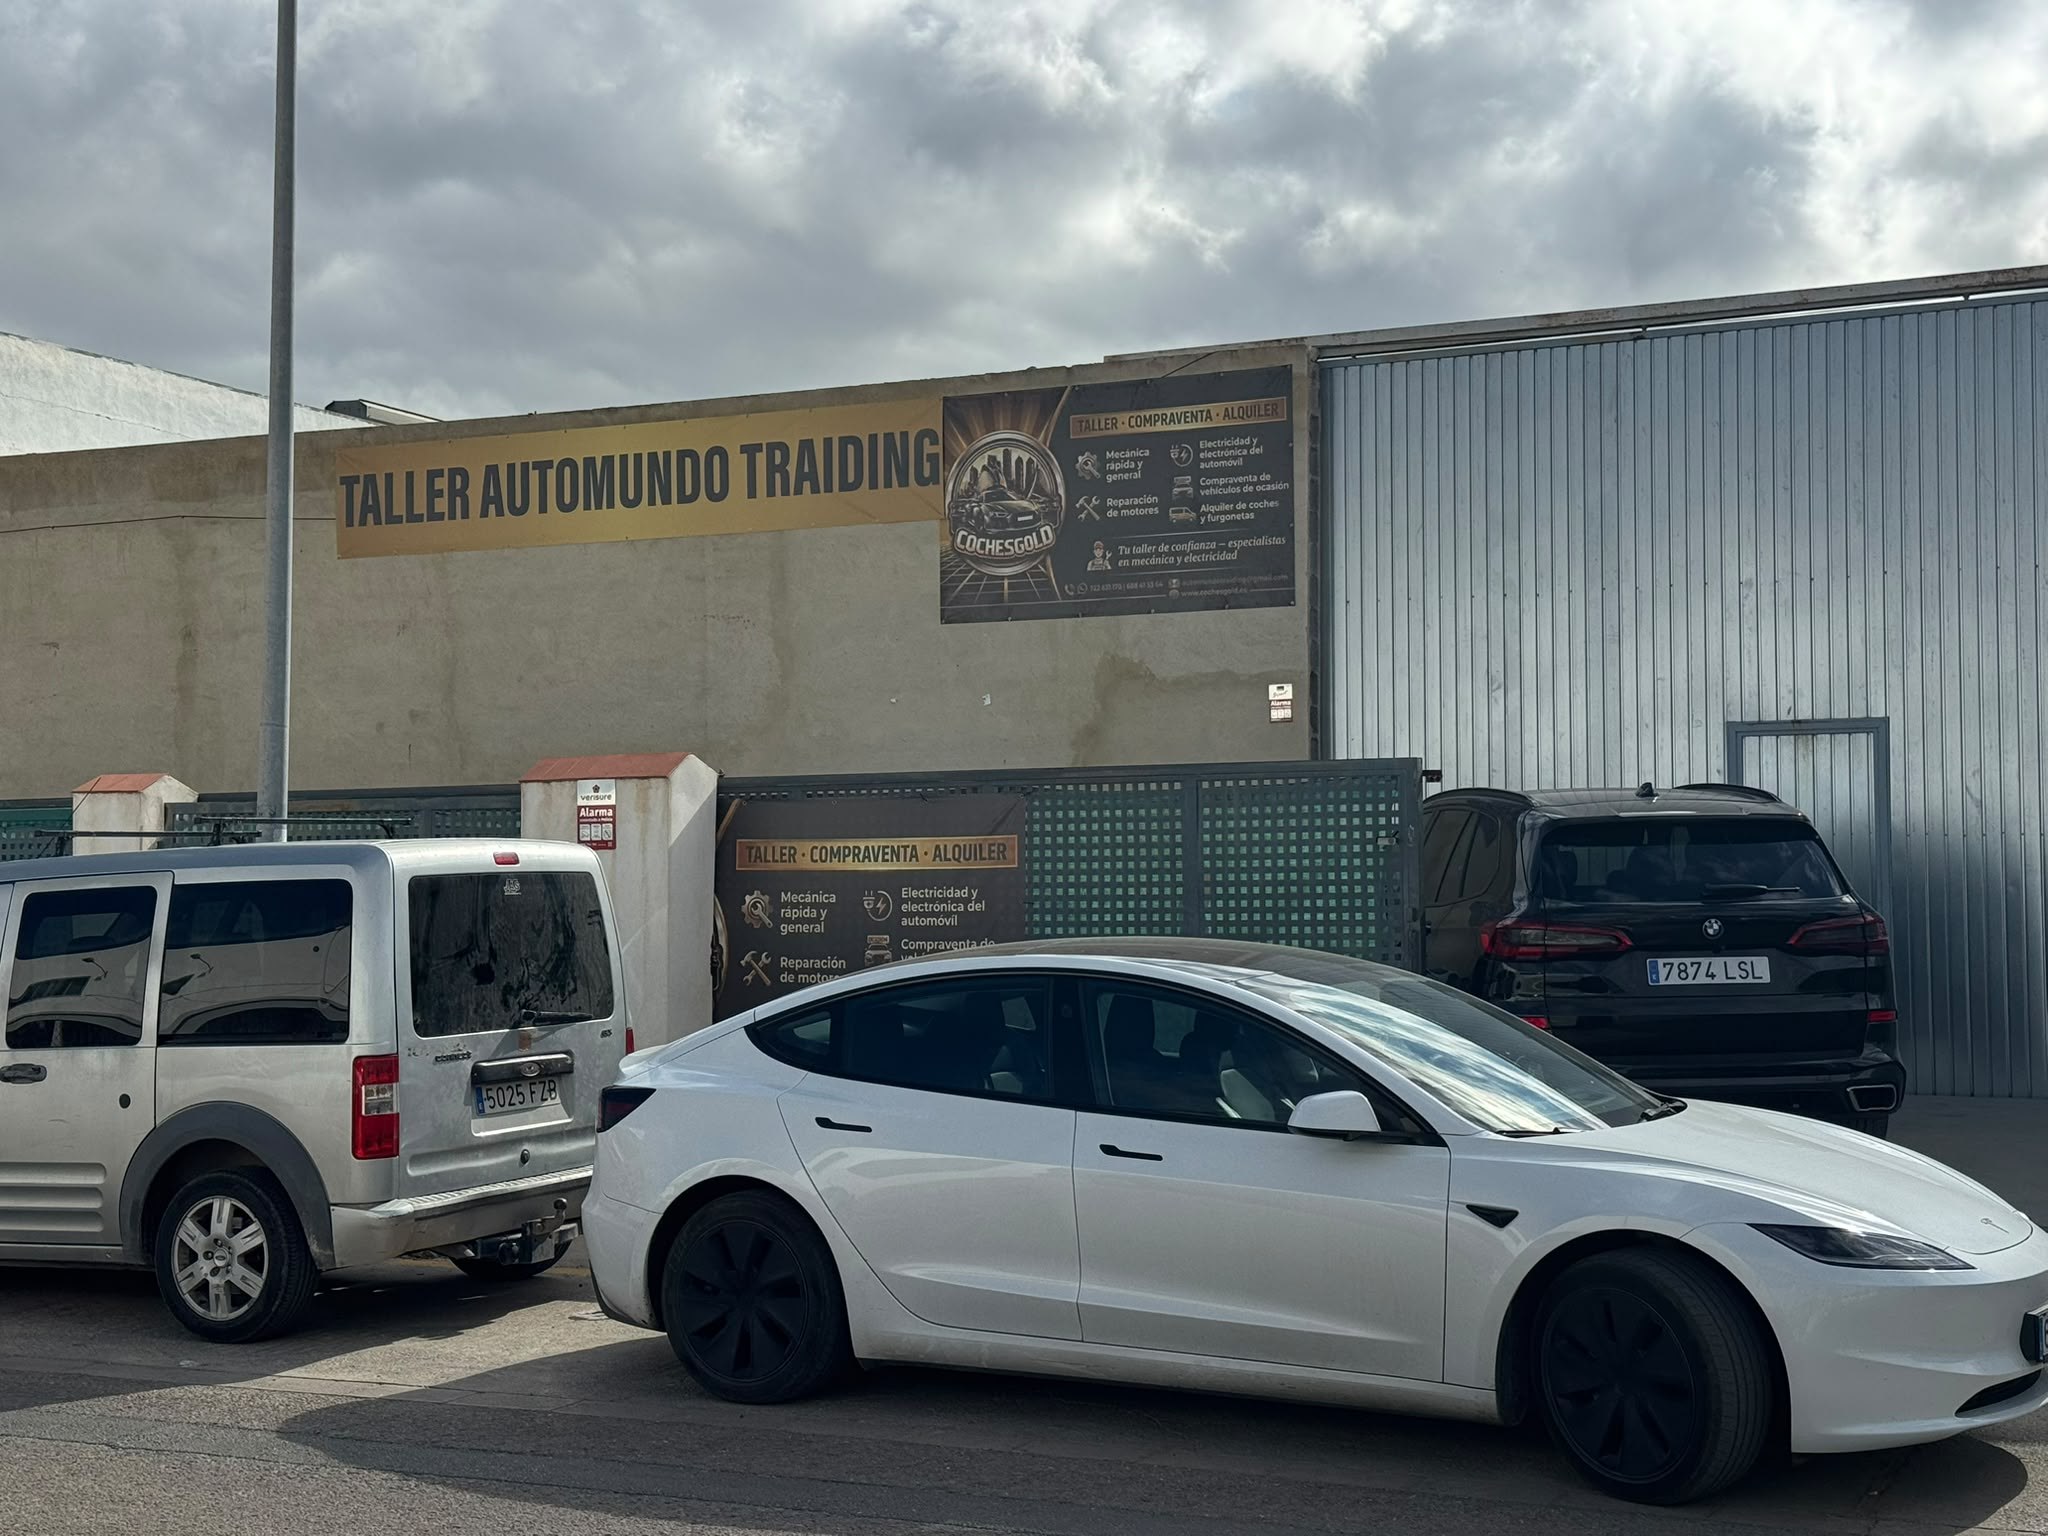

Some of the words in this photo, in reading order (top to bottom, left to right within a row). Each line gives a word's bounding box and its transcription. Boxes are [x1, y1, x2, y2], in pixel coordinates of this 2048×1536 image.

[1077, 415, 1118, 433] TALLER
[1128, 409, 1213, 430] COMPRAVENTA
[1223, 402, 1279, 421] ALQUILER
[1199, 436, 1250, 449] Electricidad
[1250, 437, 1257, 446] y
[1106, 448, 1150, 459] Mecánica
[1199, 446, 1248, 460] electrónica
[1251, 445, 1263, 455] del
[1106, 459, 1135, 471] rápida
[1135, 461, 1143, 470] y
[339, 464, 470, 528] TALLER
[479, 444, 730, 519] AUTOMUNDO
[739, 427, 941, 500] TRAIDING
[1106, 470, 1141, 483] general
[1200, 475, 1257, 487] Compraventa
[1260, 472, 1271, 482] de
[1200, 484, 1241, 496] vehículos
[1242, 483, 1253, 492] de
[1256, 481, 1289, 492] ocasión
[1107, 494, 1159, 508] Reparación
[1200, 501, 1232, 514] Alquiler
[1235, 500, 1247, 510] de
[1249, 498, 1279, 509] coches
[1107, 507, 1117, 517] de
[1120, 505, 1159, 517] motores
[1200, 514, 1207, 524] y
[1208, 510, 1255, 524] furgonetas
[955, 524, 1055, 557] COCHESGOLD
[1118, 545, 1129, 554] Tu
[1132, 543, 1157, 554] taller
[1159, 543, 1170, 552] de
[1172, 540, 1216, 554] confianza
[1228, 535, 1286, 548] especialistas
[1118, 558, 1129, 566] en
[1132, 554, 1174, 566] mecánica
[1176, 557, 1183, 566] y
[1184, 550, 1237, 563] electricidad
[579, 808, 613, 817] Alarma
[746, 845, 797, 864] TALLER
[810, 843, 919, 863] COMPRAVENTA
[932, 842, 1007, 862] ALQUILER
[781, 891, 836, 902] Mecánica
[901, 887, 968, 898] Electricidad
[971, 888, 978, 900] y
[781, 906, 817, 920] rápida
[820, 909, 827, 920] y
[901, 900, 964, 912] electrónica
[967, 900, 985, 911] del
[781, 922, 824, 935] general
[901, 939, 977, 950] Compraventa
[781, 956, 846, 970] Reparación
[780, 972, 795, 982] de
[798, 973, 840, 983] motor
[1663, 962, 1716, 981] 7874
[1724, 961, 1763, 980] LSL
[486, 1084, 526, 1109] 5025
[529, 1080, 557, 1103] FZB
